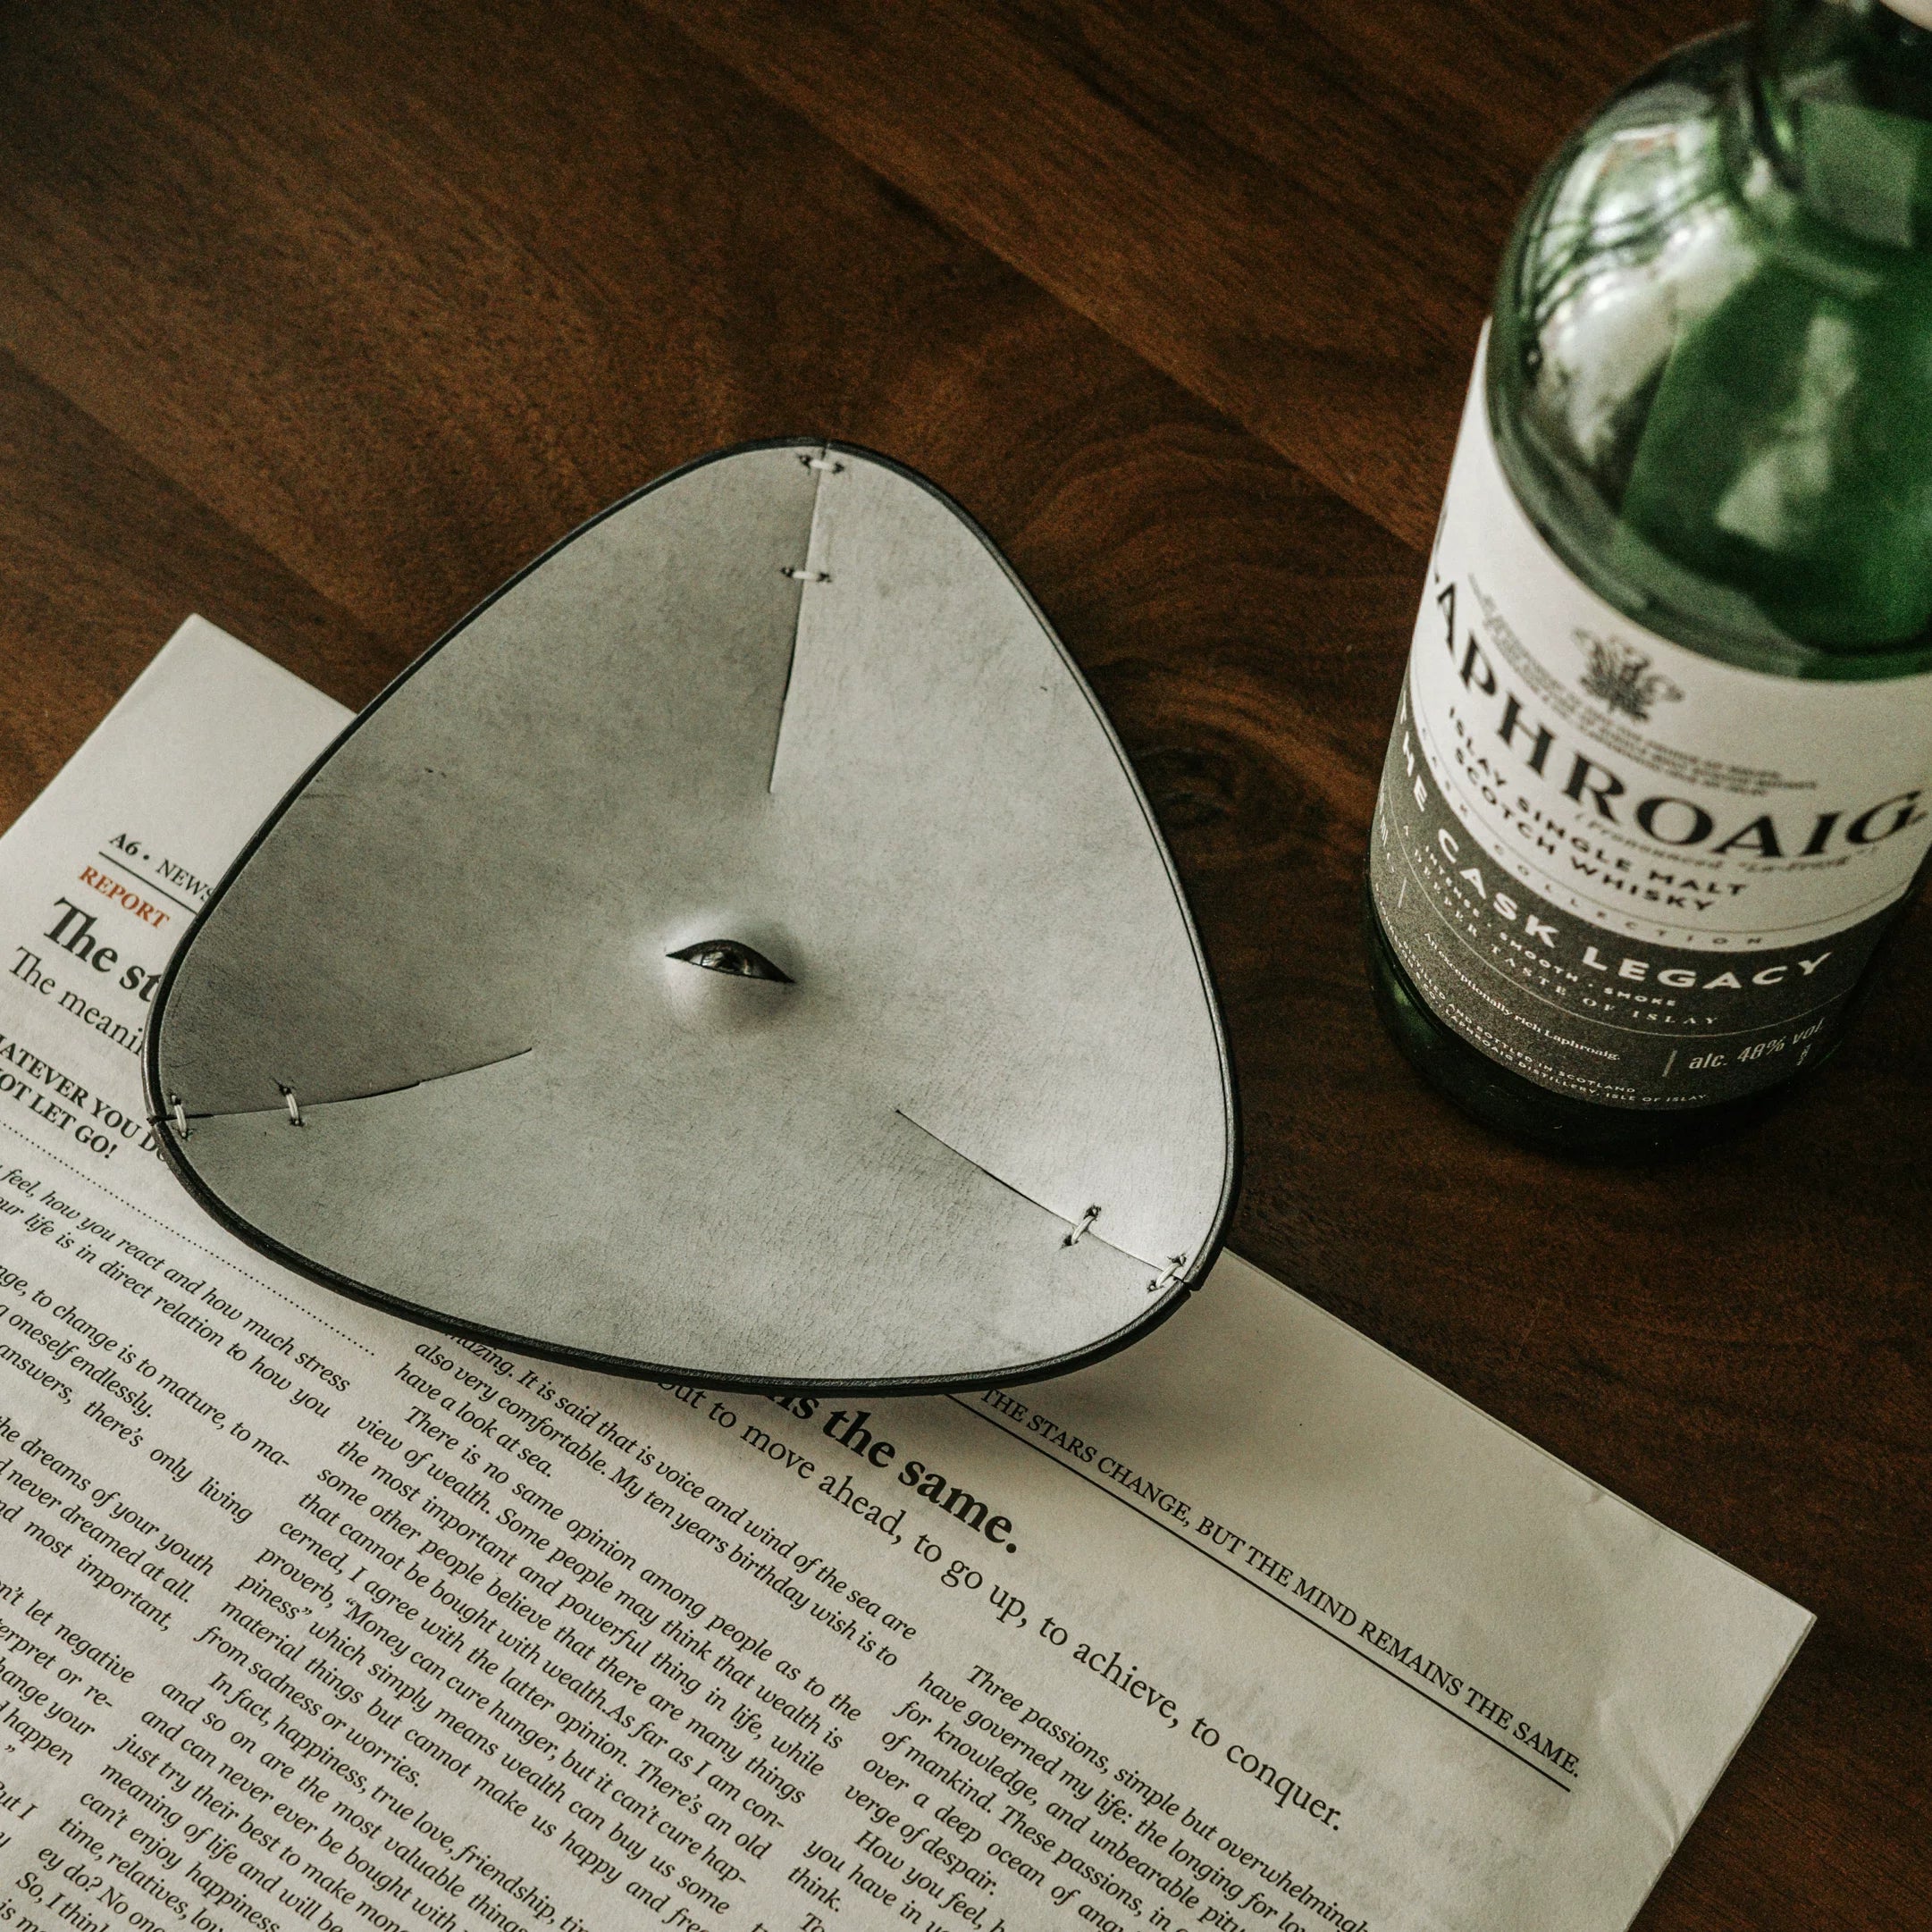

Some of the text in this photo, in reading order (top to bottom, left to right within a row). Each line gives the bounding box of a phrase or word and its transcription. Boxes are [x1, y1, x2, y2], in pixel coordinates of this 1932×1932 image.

[1434, 565, 1930, 859] APHROAIG
[109, 833, 140, 856] A6
[1399, 689, 1429, 812] THE
[1438, 827, 1560, 949] CASK
[1582, 945, 1833, 989] LEGACY
[1449, 705, 1750, 897] ISLAY SINGLE MALT
[1455, 747, 1556, 855] SCOTCH
[1570, 854, 1717, 912] WHISKY
[43, 896, 118, 973] The
[80, 866, 170, 928] REPORT
[9, 945, 55, 995] The
[1491, 943, 1567, 996] TASTE
[1582, 996, 1617, 1012] OF
[1632, 1010, 1718, 1025] ISLAY
[1499, 931, 1579, 983] SMOOTH
[1603, 987, 1677, 1008] SMOKE
[1514, 1014, 1542, 1034] rich
[1543, 1029, 1621, 1062] Laphroaig.
[91, 1096, 142, 1139] YOU
[1475, 1024, 1533, 1063] BOTTLED
[1537, 1062, 1553, 1073] IN
[1558, 1070, 1636, 1094] SCOTLAND
[1606, 1091, 1636, 1102] ISLE
[1688, 1053, 1728, 1070] alc.
[1736, 1035, 1788, 1063] 48%
[28, 1093, 77, 1130] LET
[74, 1124, 118, 1159] GO!
[0, 1169, 350, 1392] feel, how you react and how much stress
[30, 1289, 290, 1466] to change is to mature, to ma-
[21, 1437, 214, 1576] dreams of your youth
[83, 1400, 253, 1525] there’s only living
[822, 1410, 1017, 1554] the same.
[357, 1415, 844, 1749] view of wealth. Some people may think that wealth is
[404, 1406, 861, 1721] There is no same opinion among people as to the
[658, 1382, 707, 1409] ut
[708, 1401, 737, 1429] to
[739, 1424, 815, 1480] move
[818, 1475, 907, 1545] ahead,
[913, 1533, 942, 1563] to
[940, 1559, 983, 1590] go
[989, 1584, 1028, 1628] up,
[1039, 1617, 1068, 1646] to
[1072, 1643, 1179, 1729] achieve,
[1190, 1717, 1221, 1747] to
[1226, 1744, 1341, 1832] conquer.
[980, 1388, 1580, 1778] THE STARS CHANGE, BUT THE MIND REMAINS THE SAME.
[207, 1671, 556, 1925] In fact, happiness, true love, friendship,
[233, 1574, 730, 1915] piness” which simply means wealth can buy us some
[917, 1670, 1279, 1919] have governed my life: the longing for
[966, 1664, 1218, 1842] Three passions, simple but
[80, 1793, 183, 1870] can’t enjoy
[844, 1785, 997, 1896] verge of despair.
[881, 1732, 1172, 1932] of mankind. These passions, in
